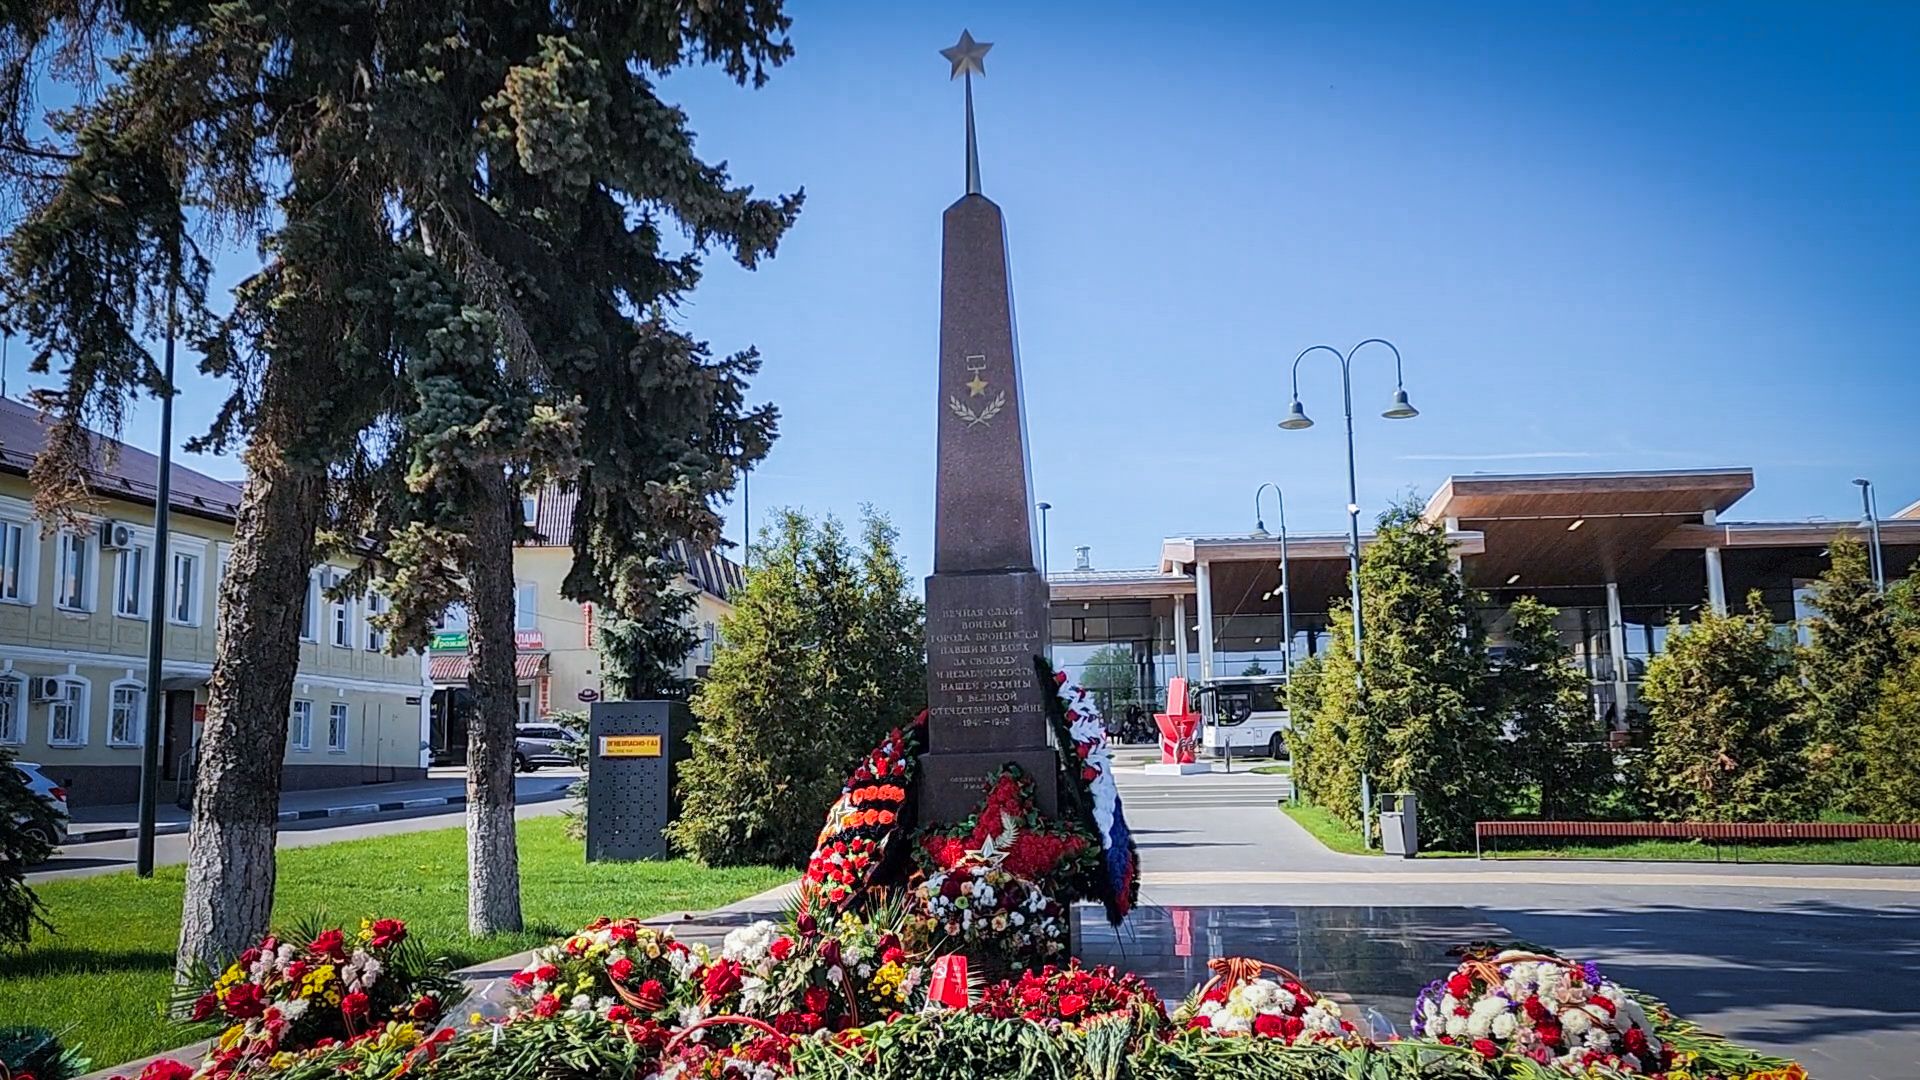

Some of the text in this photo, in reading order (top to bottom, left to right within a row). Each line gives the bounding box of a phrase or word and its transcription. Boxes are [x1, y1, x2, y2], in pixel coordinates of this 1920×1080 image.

[942, 607, 1023, 618] ВЕЧНАЯ СЛАВА
[961, 620, 1007, 630] ВОИНАМ
[930, 633, 971, 643] ГОРОДА
[940, 643, 1031, 655] ПАВШИМ В БОЯХ
[953, 656, 1018, 666] ЗА СВОБОДУ
[936, 668, 1034, 679] И НЕЗАВИСИМОСТЬ
[940, 680, 1031, 691] НАШЕЙ РОДИНЫ
[956, 691, 1017, 703] В ВЕЛИКОЙ
[930, 703, 1042, 715] ОТЕЧЕСТВЕННОЙ ВОЙНЕ
